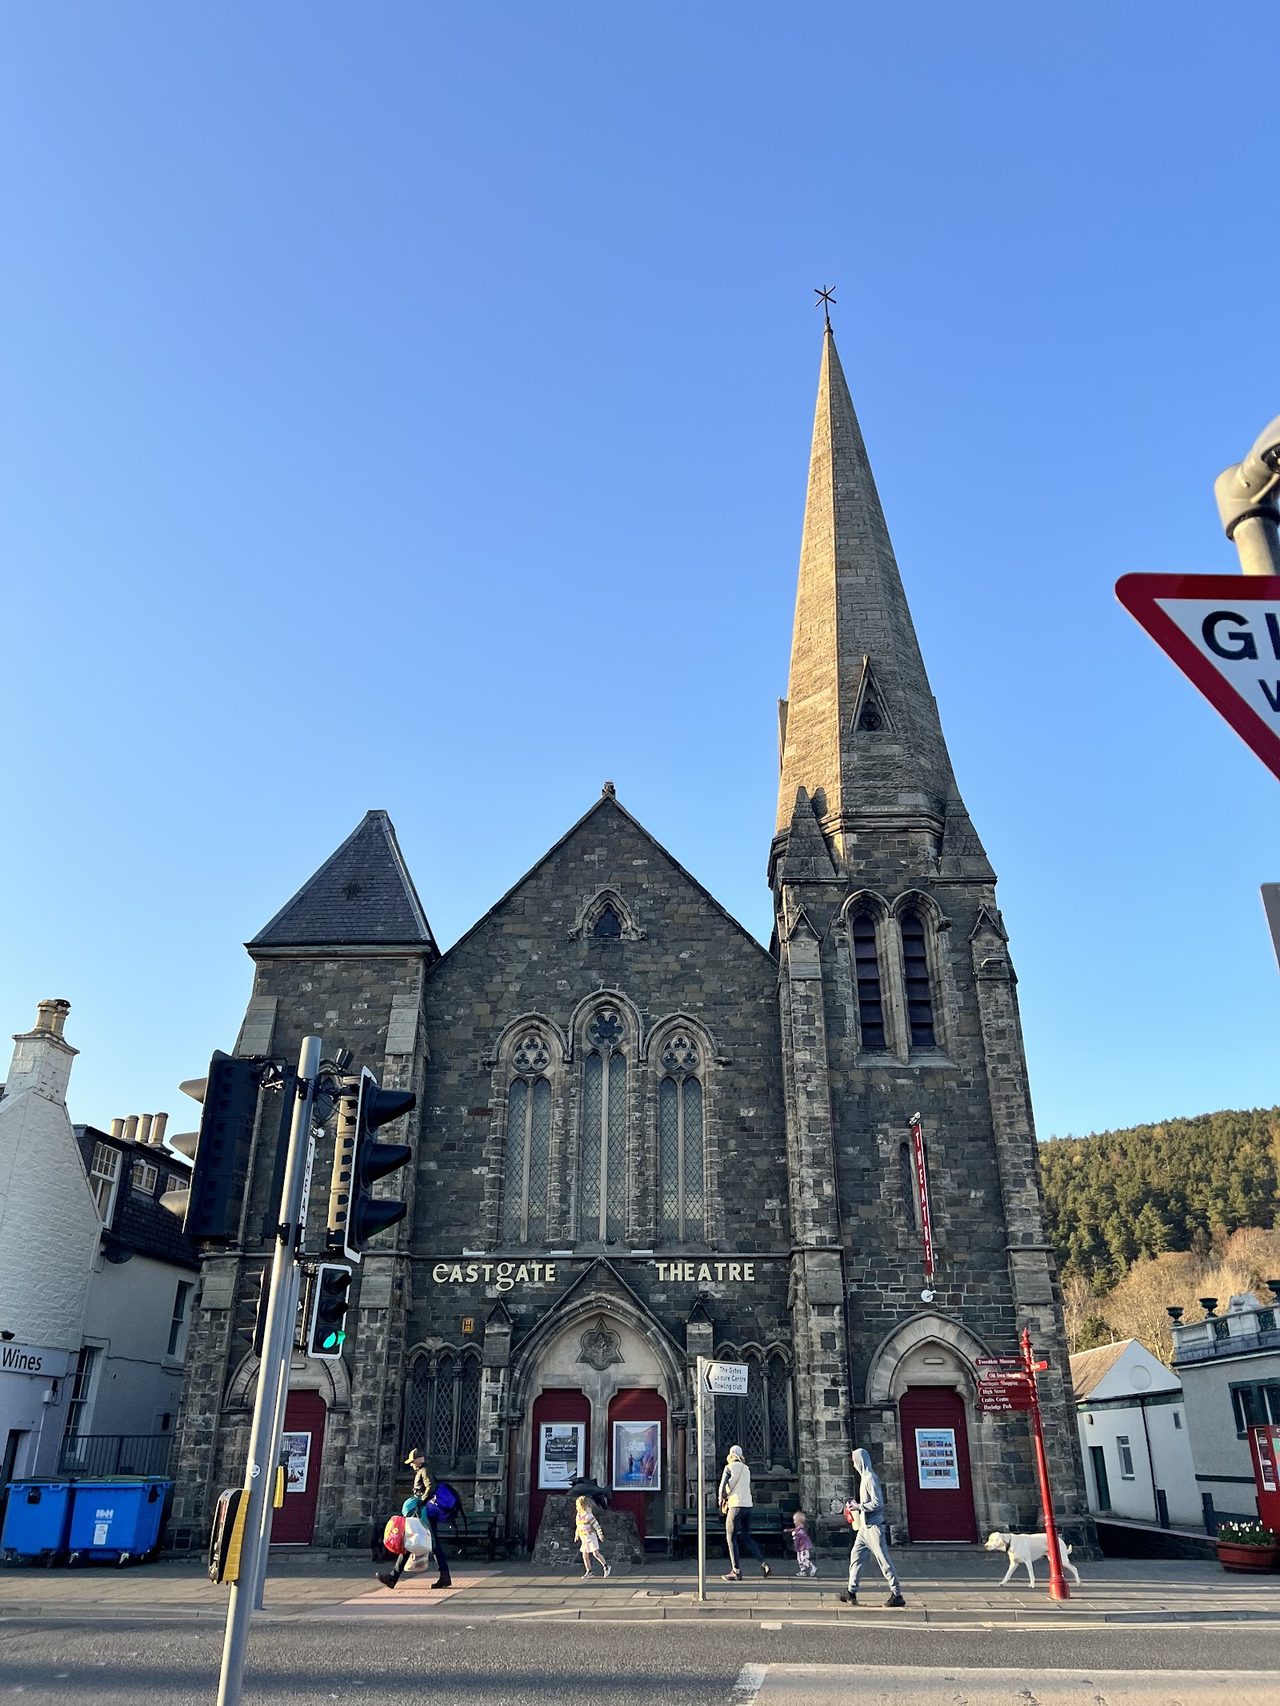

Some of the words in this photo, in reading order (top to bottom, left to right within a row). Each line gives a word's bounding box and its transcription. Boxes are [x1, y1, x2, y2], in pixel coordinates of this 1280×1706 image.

[915, 1132, 931, 1261] THEATRE
[655, 1263, 755, 1281] THEATRE
[2, 1347, 43, 1371] Wines
[719, 1366, 728, 1374] The
[731, 1375, 746, 1383] Centre
